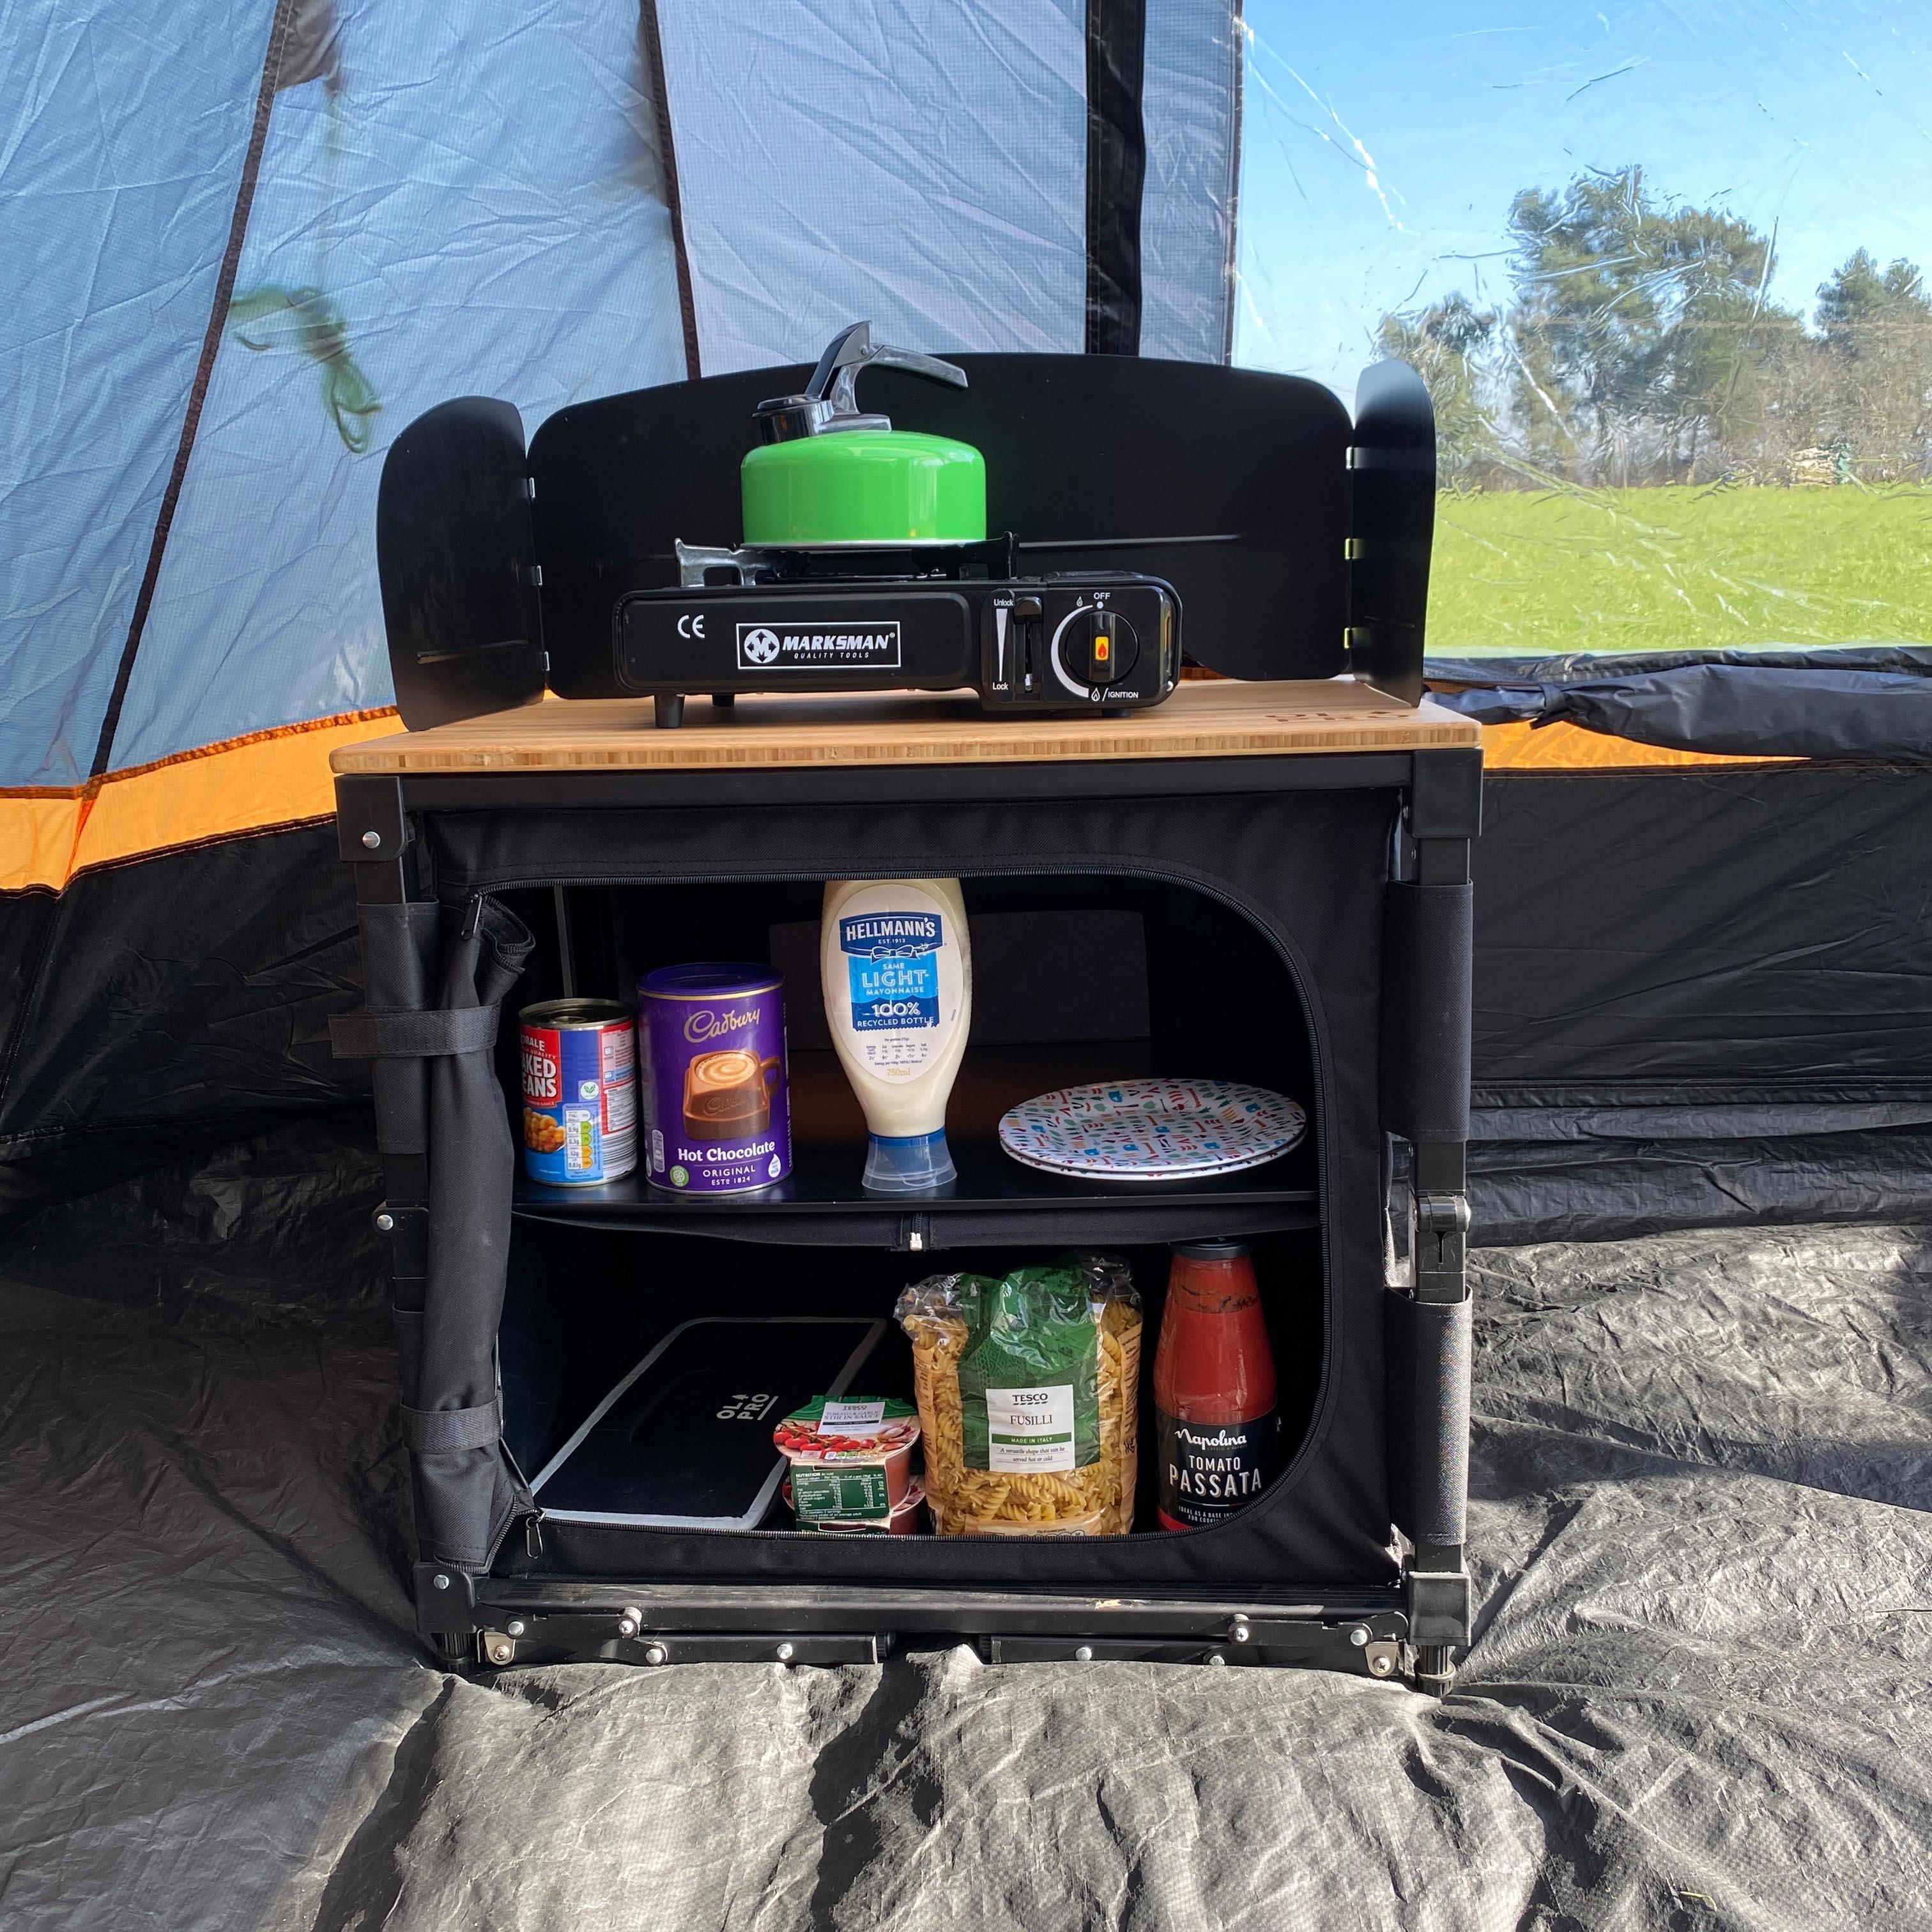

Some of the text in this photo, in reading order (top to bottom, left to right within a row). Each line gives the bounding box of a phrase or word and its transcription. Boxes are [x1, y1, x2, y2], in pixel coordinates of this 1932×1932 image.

[993, 599, 1015, 607] Unlock
[677, 614, 705, 638] CE
[782, 634, 889, 650] MARKSMAN
[992, 682, 1009, 691] Lock
[846, 917, 935, 942] HELLMANN'S
[862, 969, 926, 988] LIGHT
[866, 986, 924, 995] MAYONNAISE
[871, 1001, 921, 1018] 100%
[683, 1008, 760, 1043] Cadbury
[857, 1016, 934, 1027] RECYCLED BOTTLE
[886, 1067, 910, 1077] 750ml
[677, 1140, 775, 1162] Hot Chocolate
[702, 1165, 756, 1177] ORIGINAL
[733, 1176, 751, 1184] 1824
[1012, 1393, 1048, 1402] TESCO
[737, 1393, 769, 1420] PRO
[1009, 1414, 1053, 1425] FUSILLI
[1174, 1428, 1247, 1450] Napolina
[1188, 1454, 1241, 1471] TOMATO
[1169, 1463, 1262, 1498] PASSATA
[1179, 1505, 1193, 1515] IDEAL
